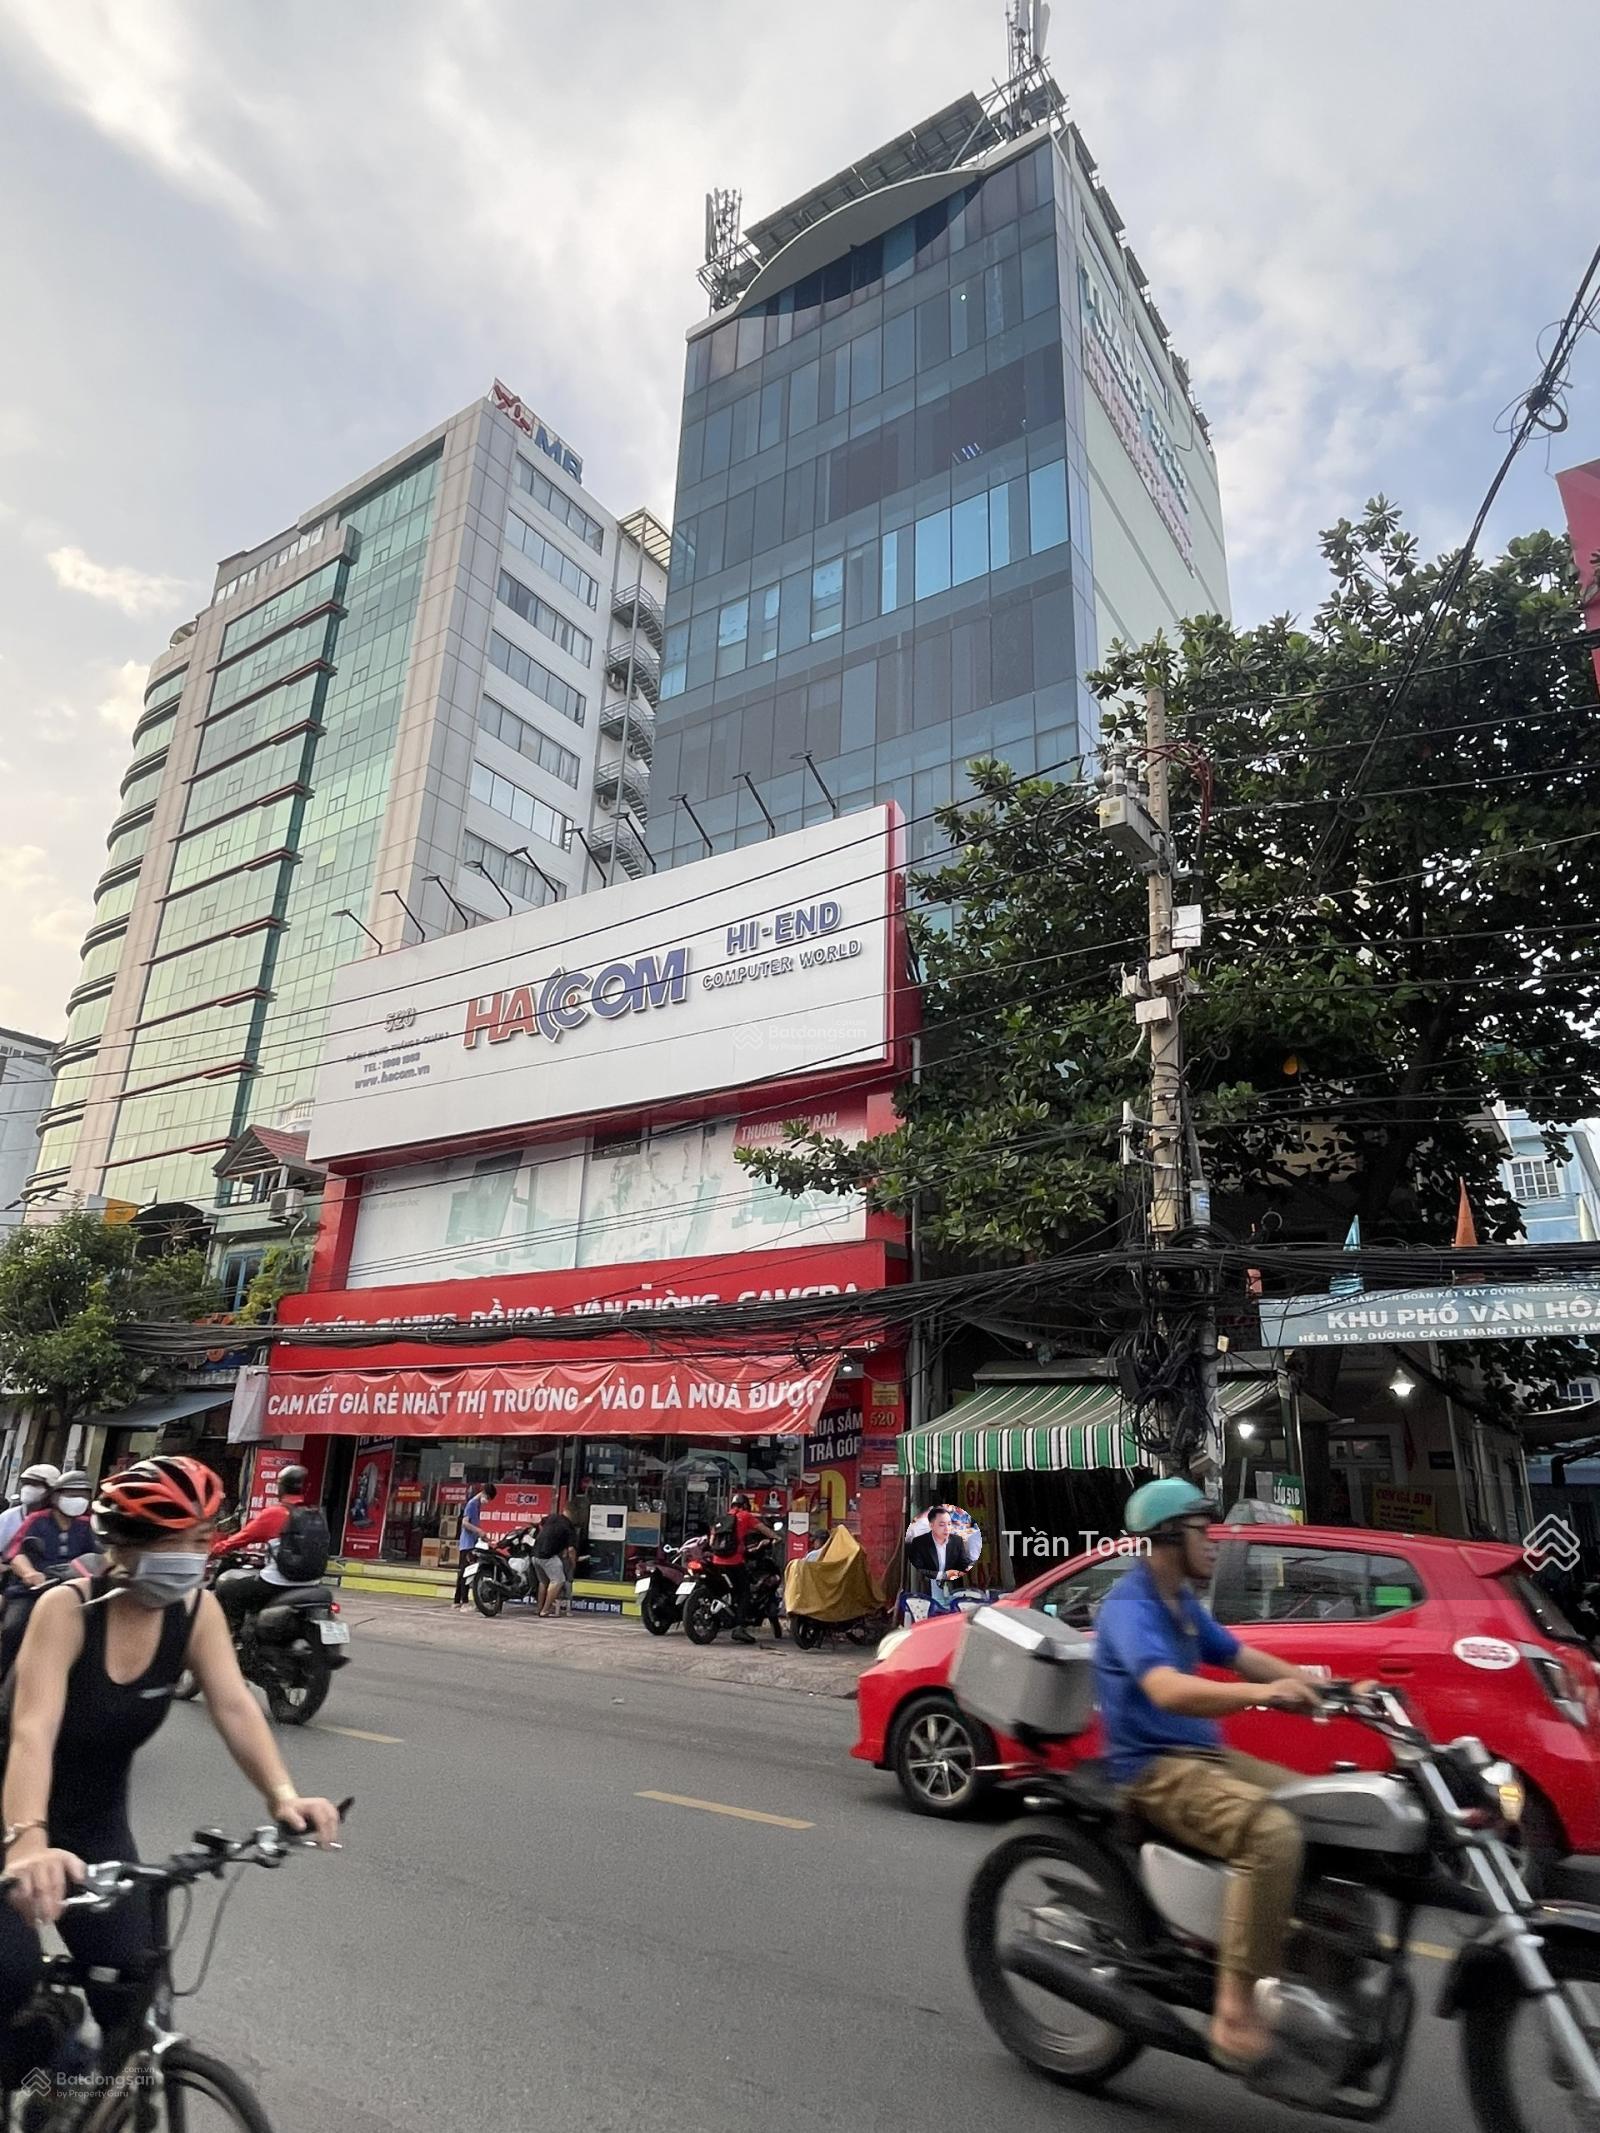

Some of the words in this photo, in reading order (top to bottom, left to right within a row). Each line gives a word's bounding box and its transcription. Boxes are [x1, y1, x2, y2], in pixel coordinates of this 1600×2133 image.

[725, 901, 841, 956] HI-END
[702, 956, 792, 990] COMPUTER
[800, 940, 861, 969] WORLD
[812, 1111, 838, 1129] RAM
[1327, 1309, 1388, 1330] KHU
[1397, 1300, 1460, 1326] PHỐ
[1468, 1299, 1535, 1323] VĂN
[267, 1394, 303, 1416] CAM
[305, 1385, 338, 1415] KẾT
[339, 1386, 370, 1415] GIÁ
[372, 1385, 399, 1415] RẺ
[401, 1384, 452, 1415] NHẤT
[456, 1390, 489, 1420] THỊ
[492, 1382, 578, 1414] TRƯỜNG
[601, 1376, 645, 1410] VÀO
[650, 1375, 683, 1410] LÀ
[687, 1383, 741, 1410] MUA
[809, 1436, 834, 1463] TRẢ
